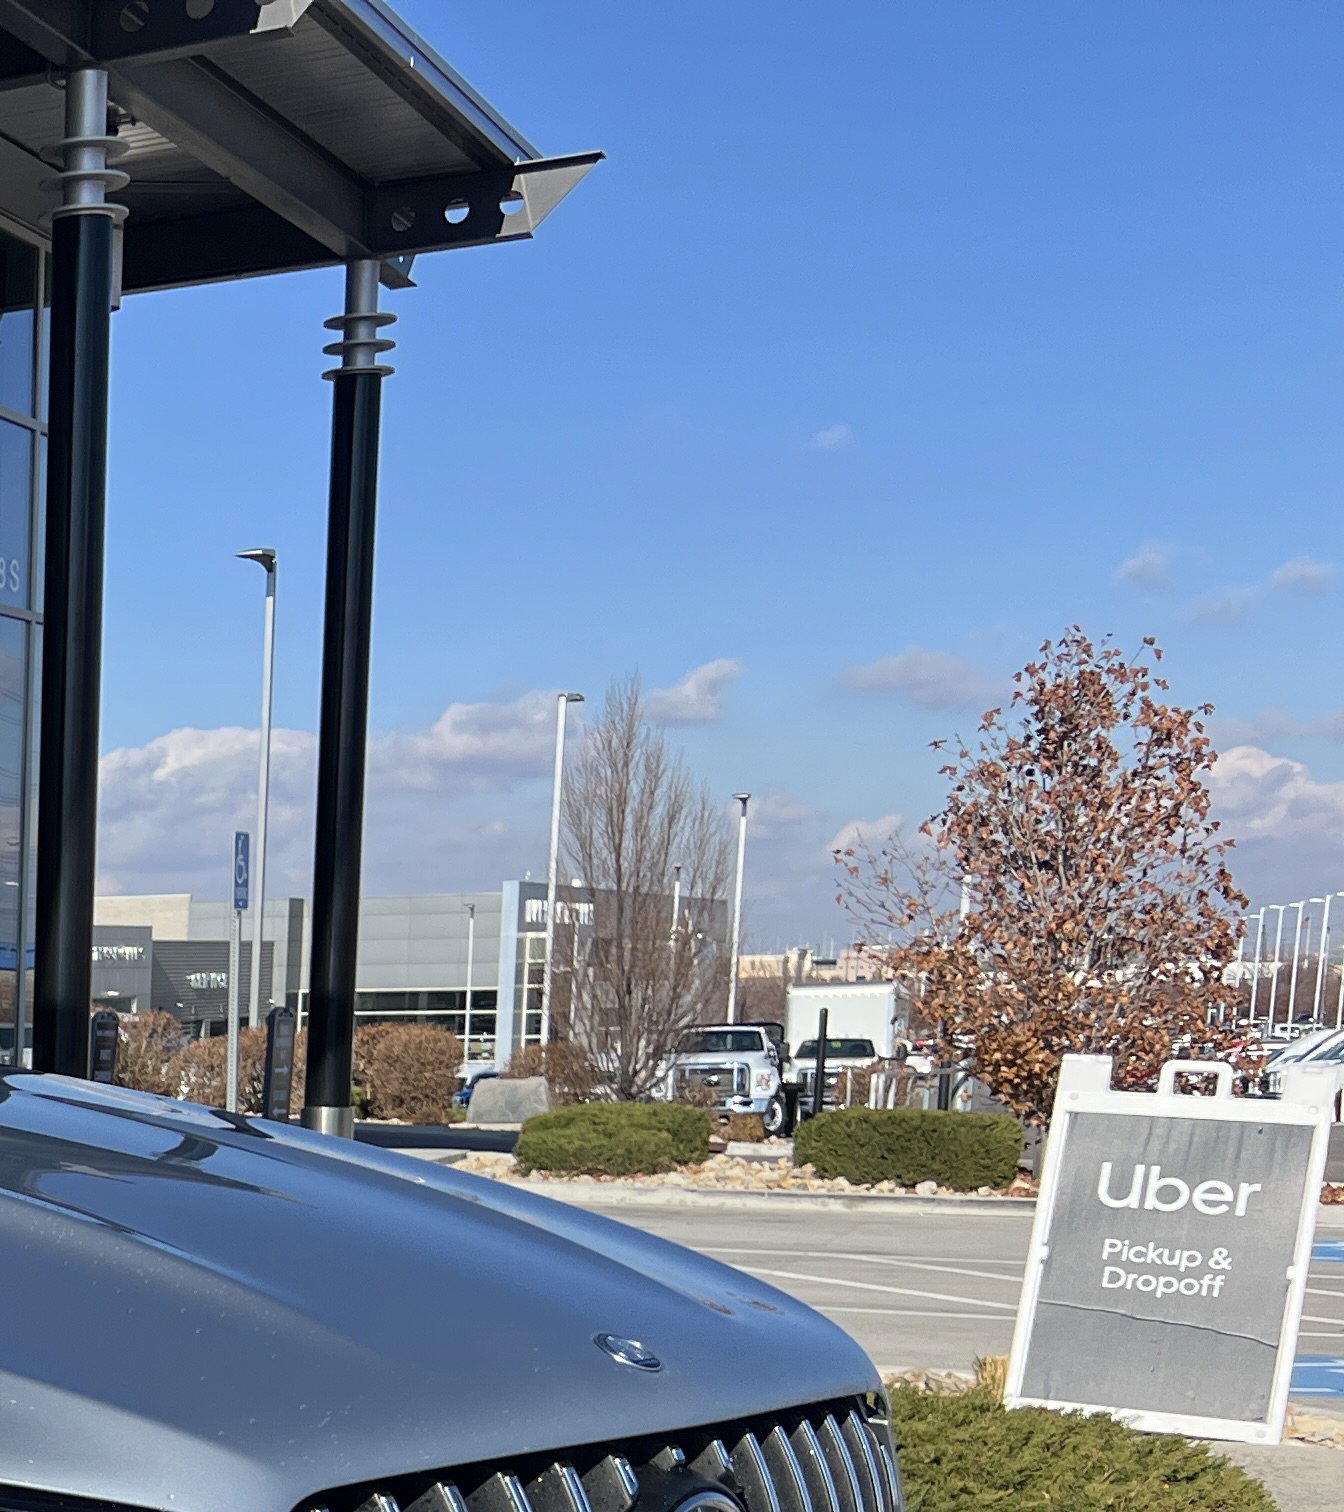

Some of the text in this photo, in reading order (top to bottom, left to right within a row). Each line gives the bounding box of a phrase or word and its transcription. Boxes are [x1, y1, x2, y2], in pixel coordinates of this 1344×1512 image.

[10, 558, 20, 593] S
[1097, 1161, 1262, 1217] Uber
[1101, 1237, 1233, 1273] Pickup &
[1101, 1265, 1226, 1299] Dropoff
